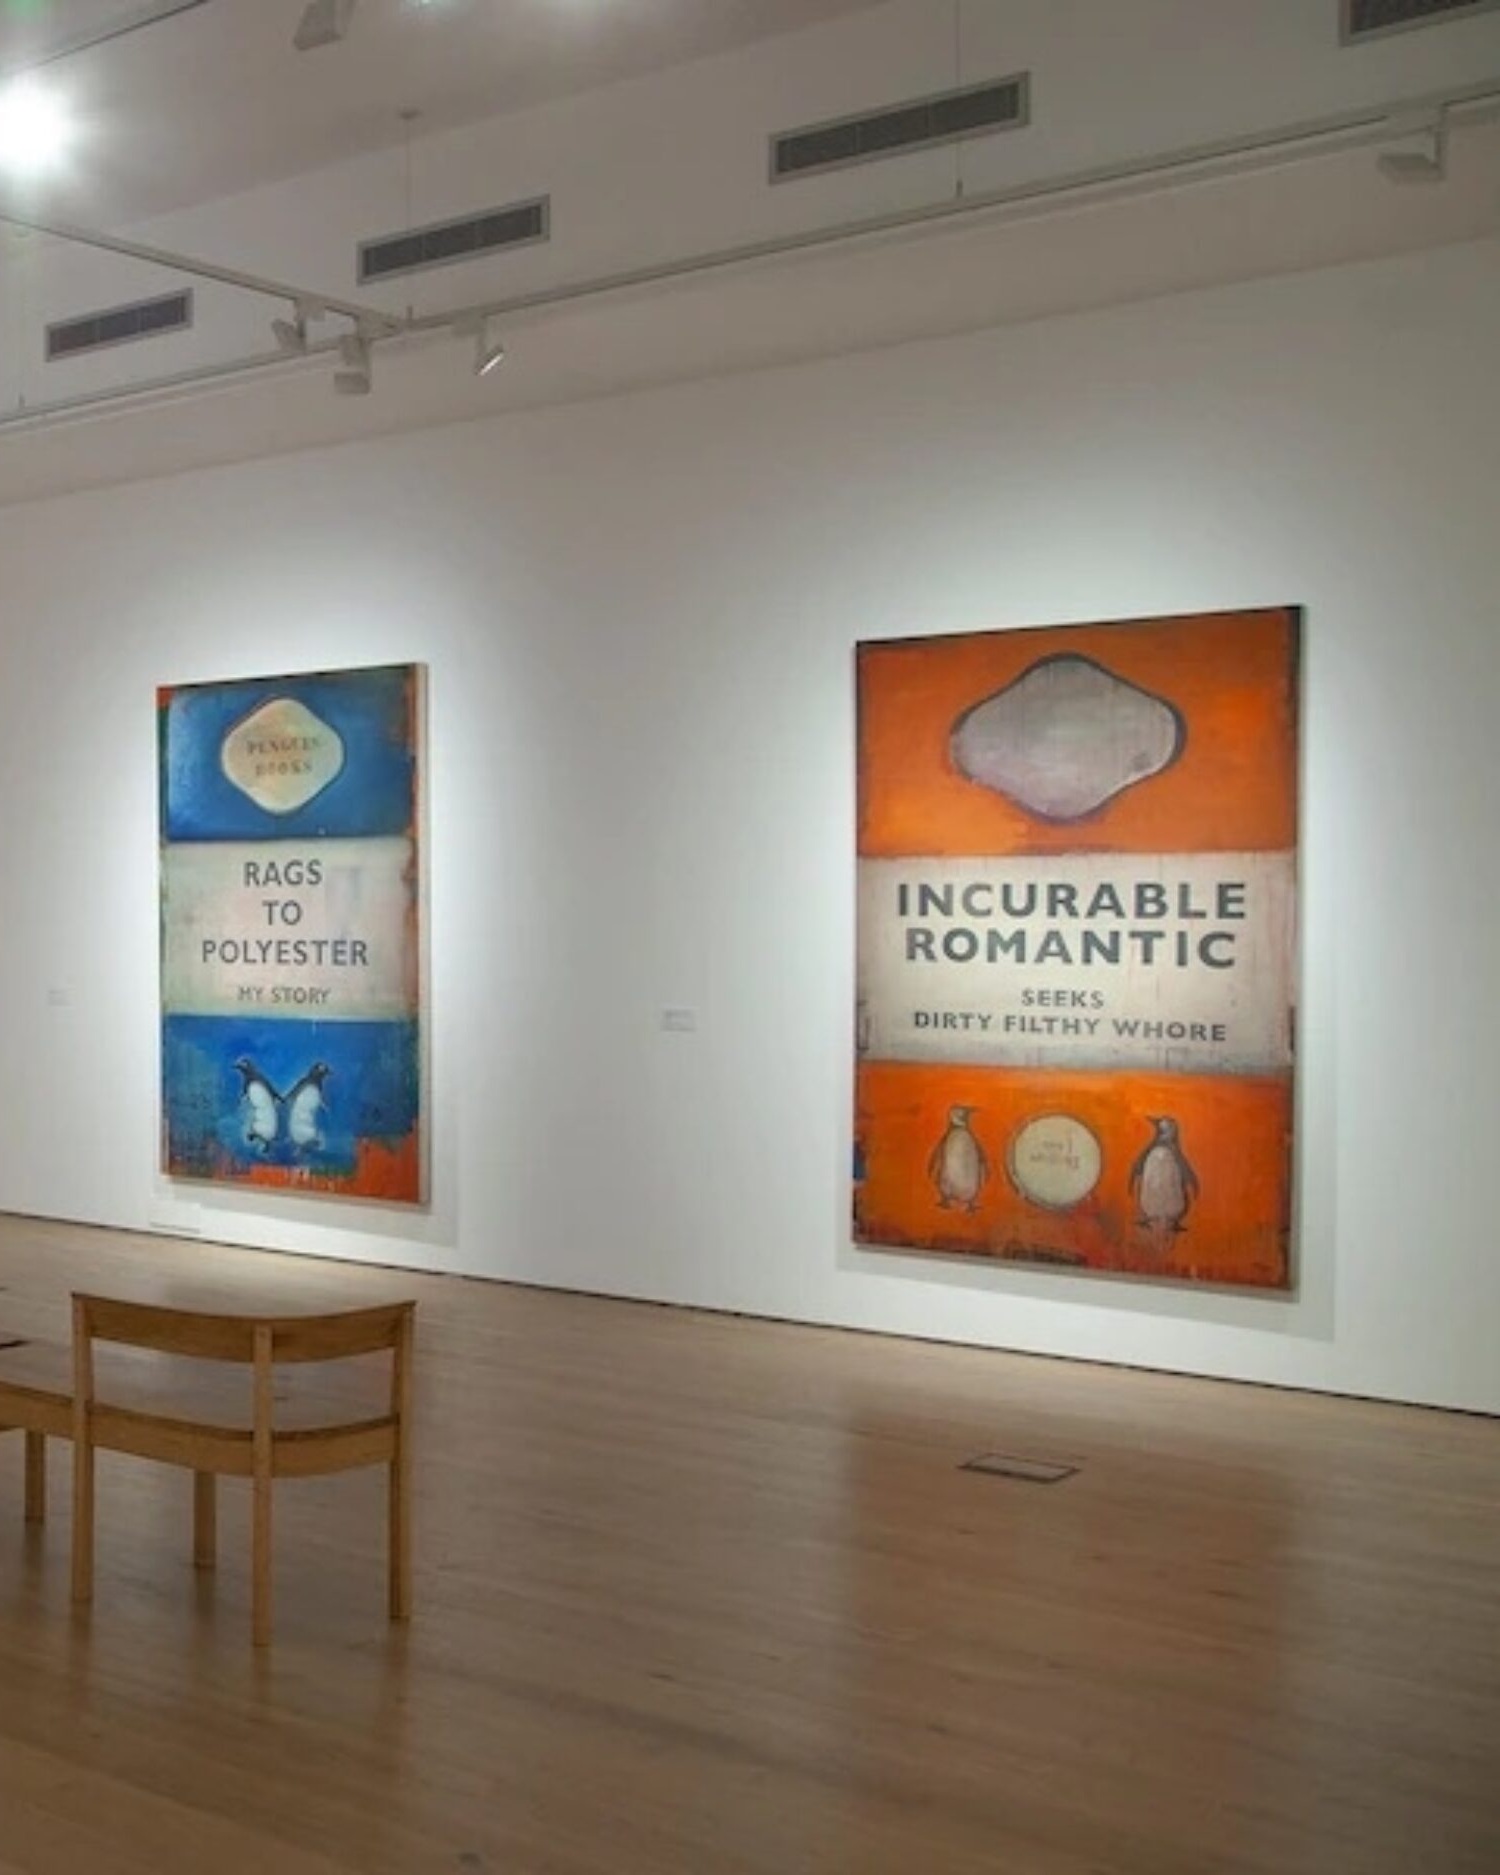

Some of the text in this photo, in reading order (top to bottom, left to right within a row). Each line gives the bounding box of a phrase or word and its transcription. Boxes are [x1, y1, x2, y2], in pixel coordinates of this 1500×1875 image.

[243, 858, 323, 887] RAGS
[261, 899, 304, 926] TO
[897, 882, 1247, 920] INCURABLE
[201, 938, 370, 967] POLYESTER
[904, 926, 1237, 969] ROMANTIC
[237, 985, 332, 1004] MY STORY
[1020, 987, 1106, 1010] SEEKS
[912, 1010, 1228, 1042] DIRTY FILTHY WHORE
